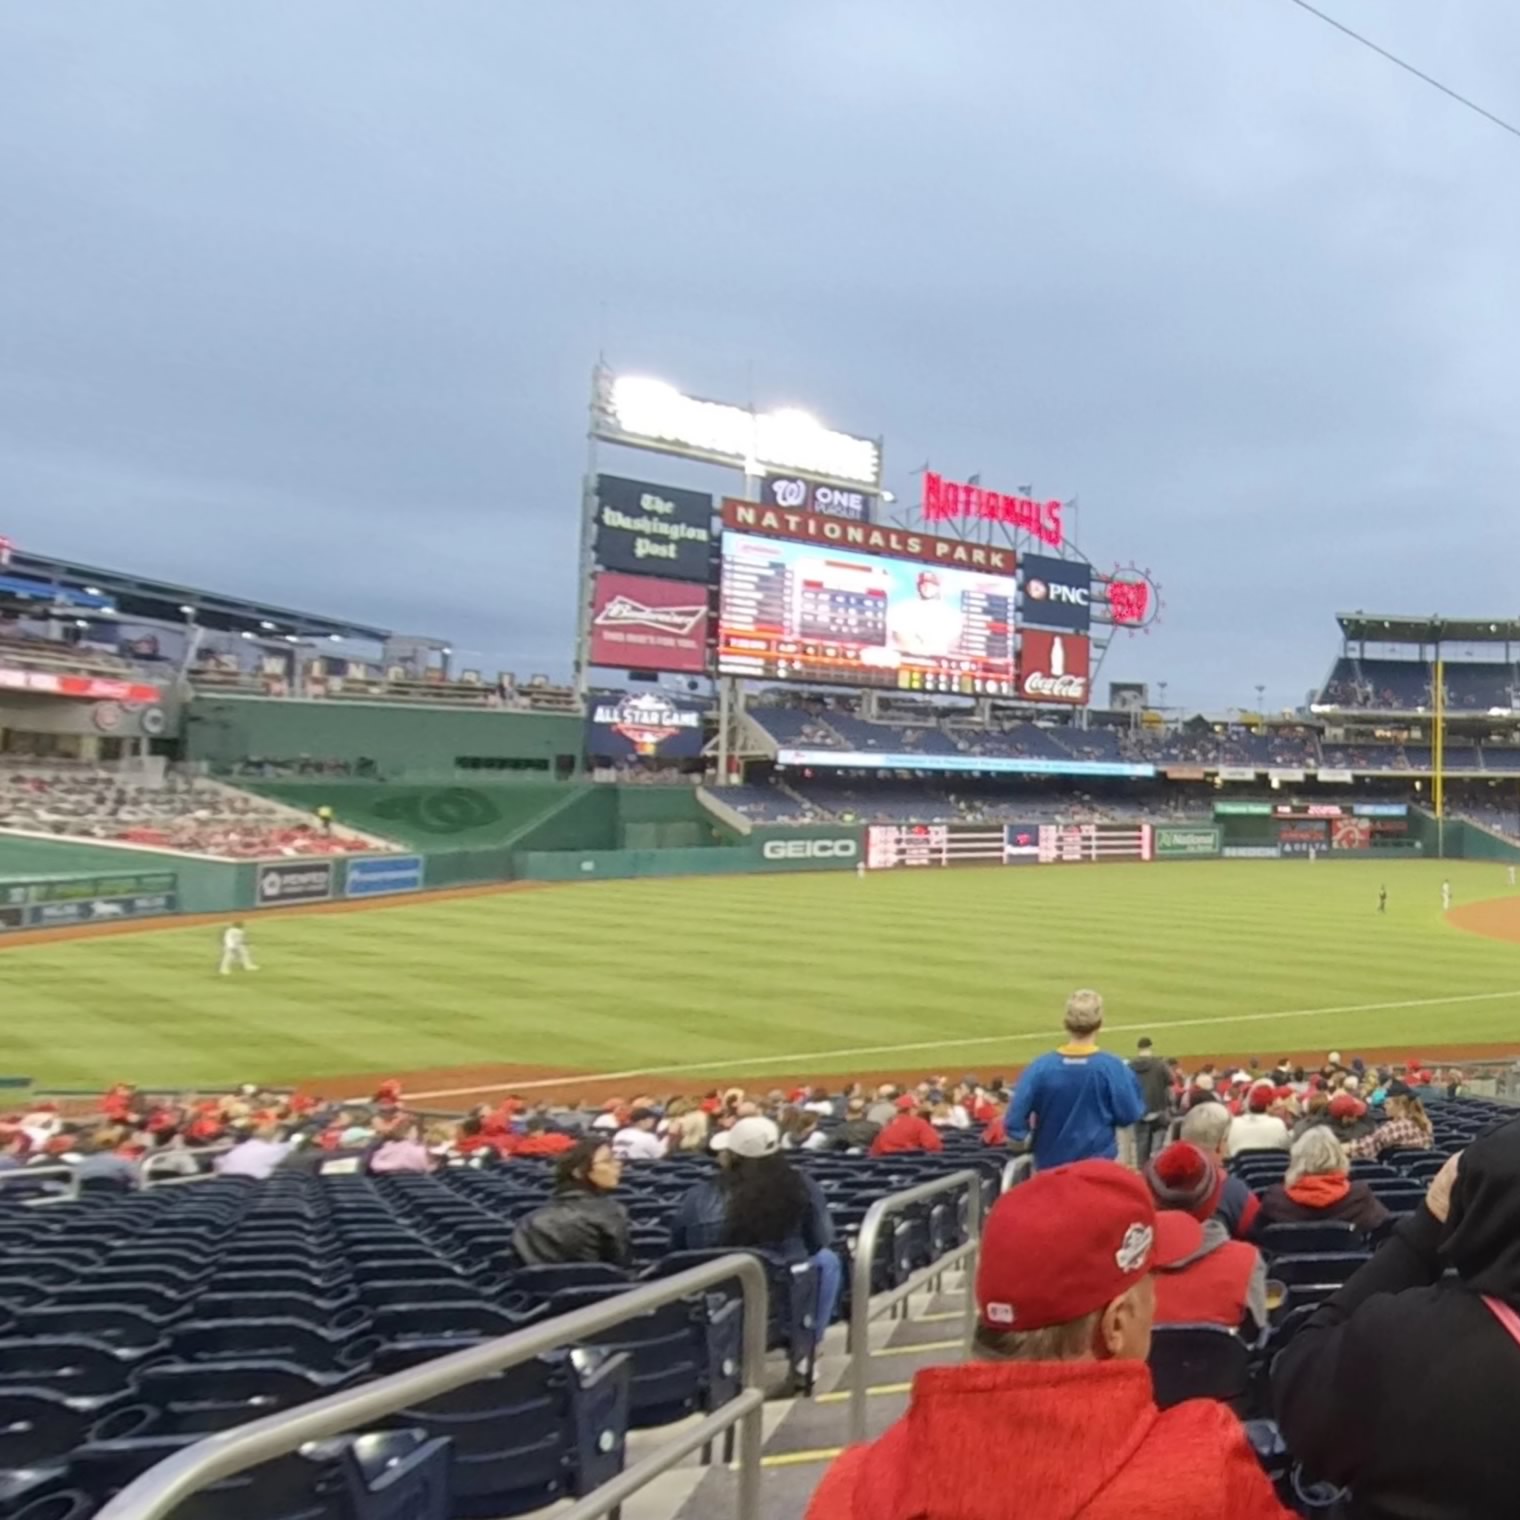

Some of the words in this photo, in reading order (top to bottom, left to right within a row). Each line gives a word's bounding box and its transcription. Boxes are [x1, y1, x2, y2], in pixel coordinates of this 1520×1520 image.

[641, 493, 674, 514] The
[816, 487, 863, 511] ONE
[922, 470, 1064, 549] NATIONALS
[602, 505, 708, 541] Washington
[634, 537, 677, 558] Post
[736, 506, 922, 553] NATIONALS
[936, 541, 1005, 567] PARK
[1048, 582, 1089, 606] PNC
[594, 705, 621, 723] ALL
[622, 708, 659, 725] STAR
[661, 710, 699, 728] GAME
[763, 839, 857, 859] GEICO
